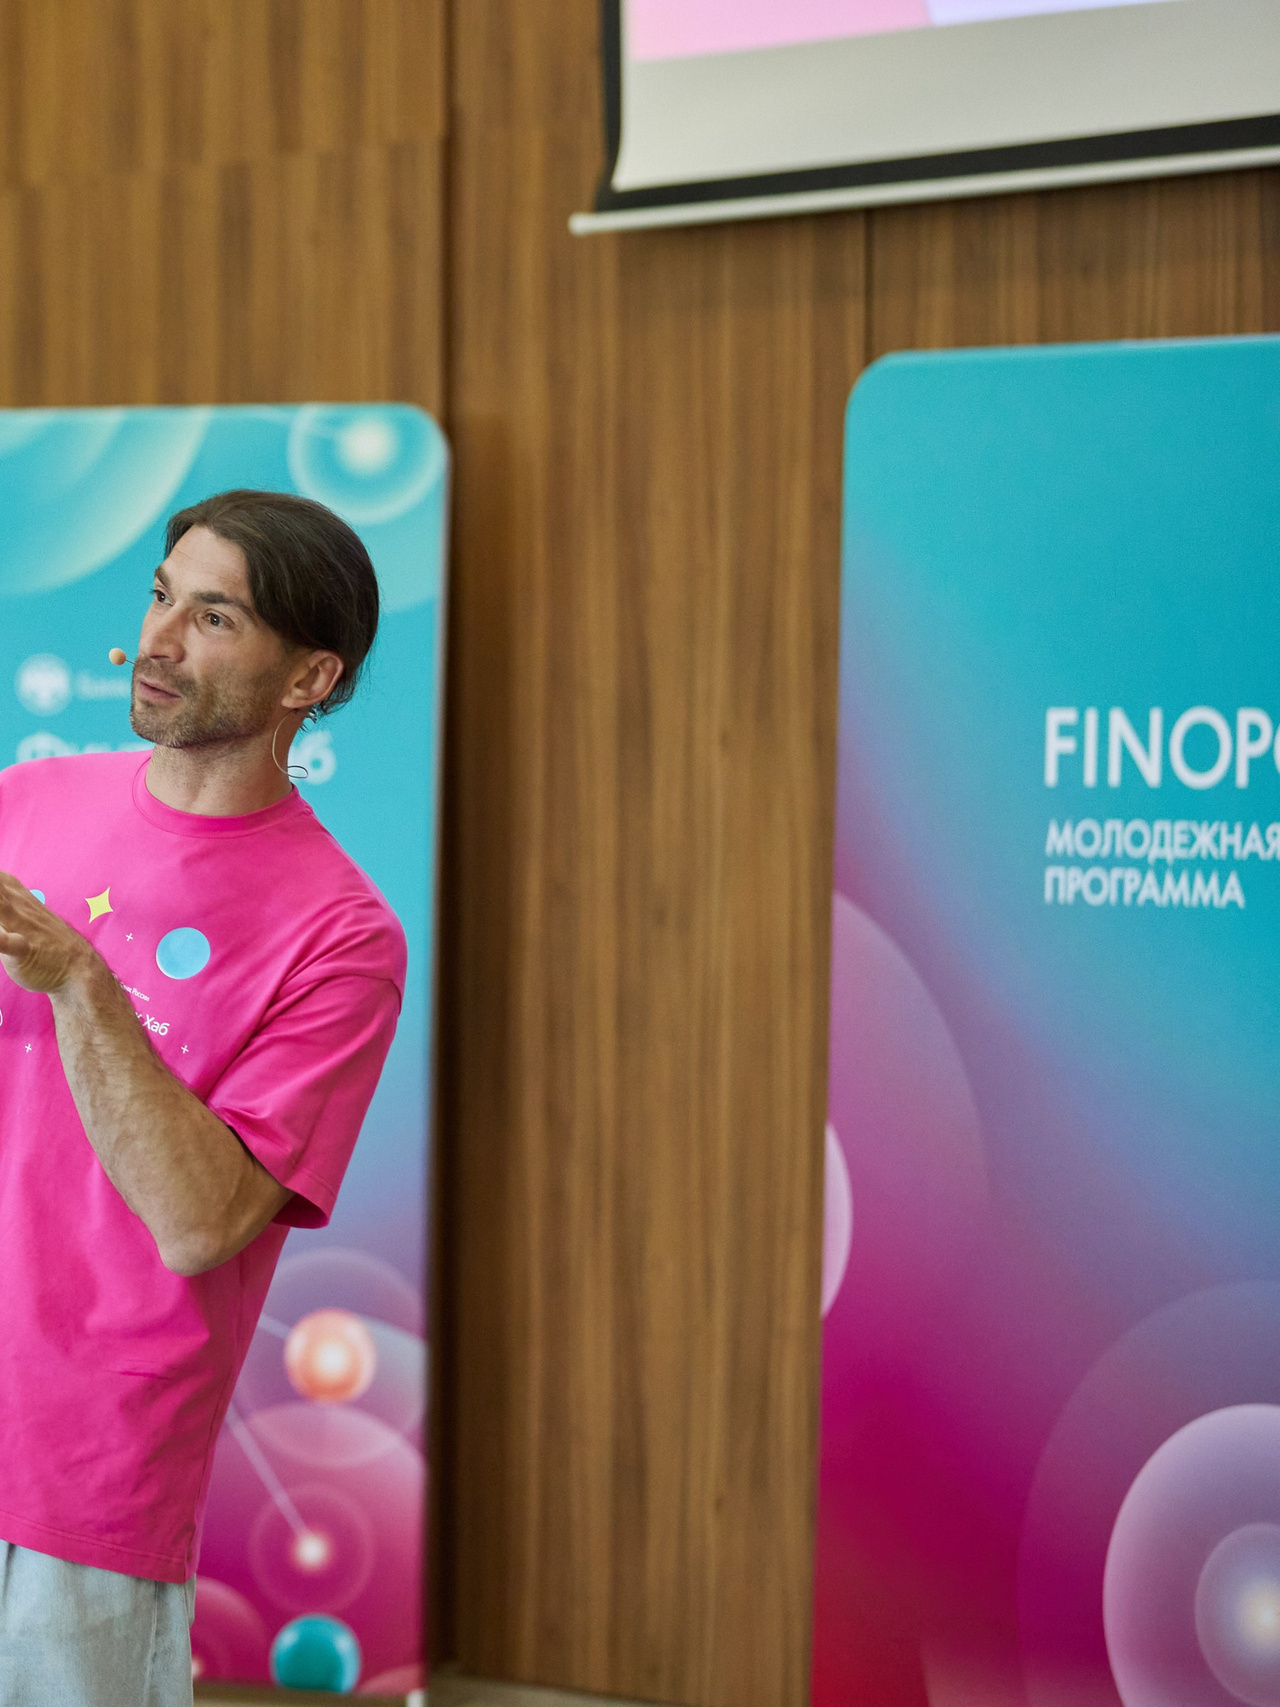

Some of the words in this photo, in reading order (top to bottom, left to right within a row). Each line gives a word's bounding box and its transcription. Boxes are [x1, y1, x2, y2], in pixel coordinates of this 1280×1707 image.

[1043, 706, 1280, 790] FINOP
[1043, 865, 1245, 909] ПРОГРАММА
[142, 1014, 170, 1036] Хаб
